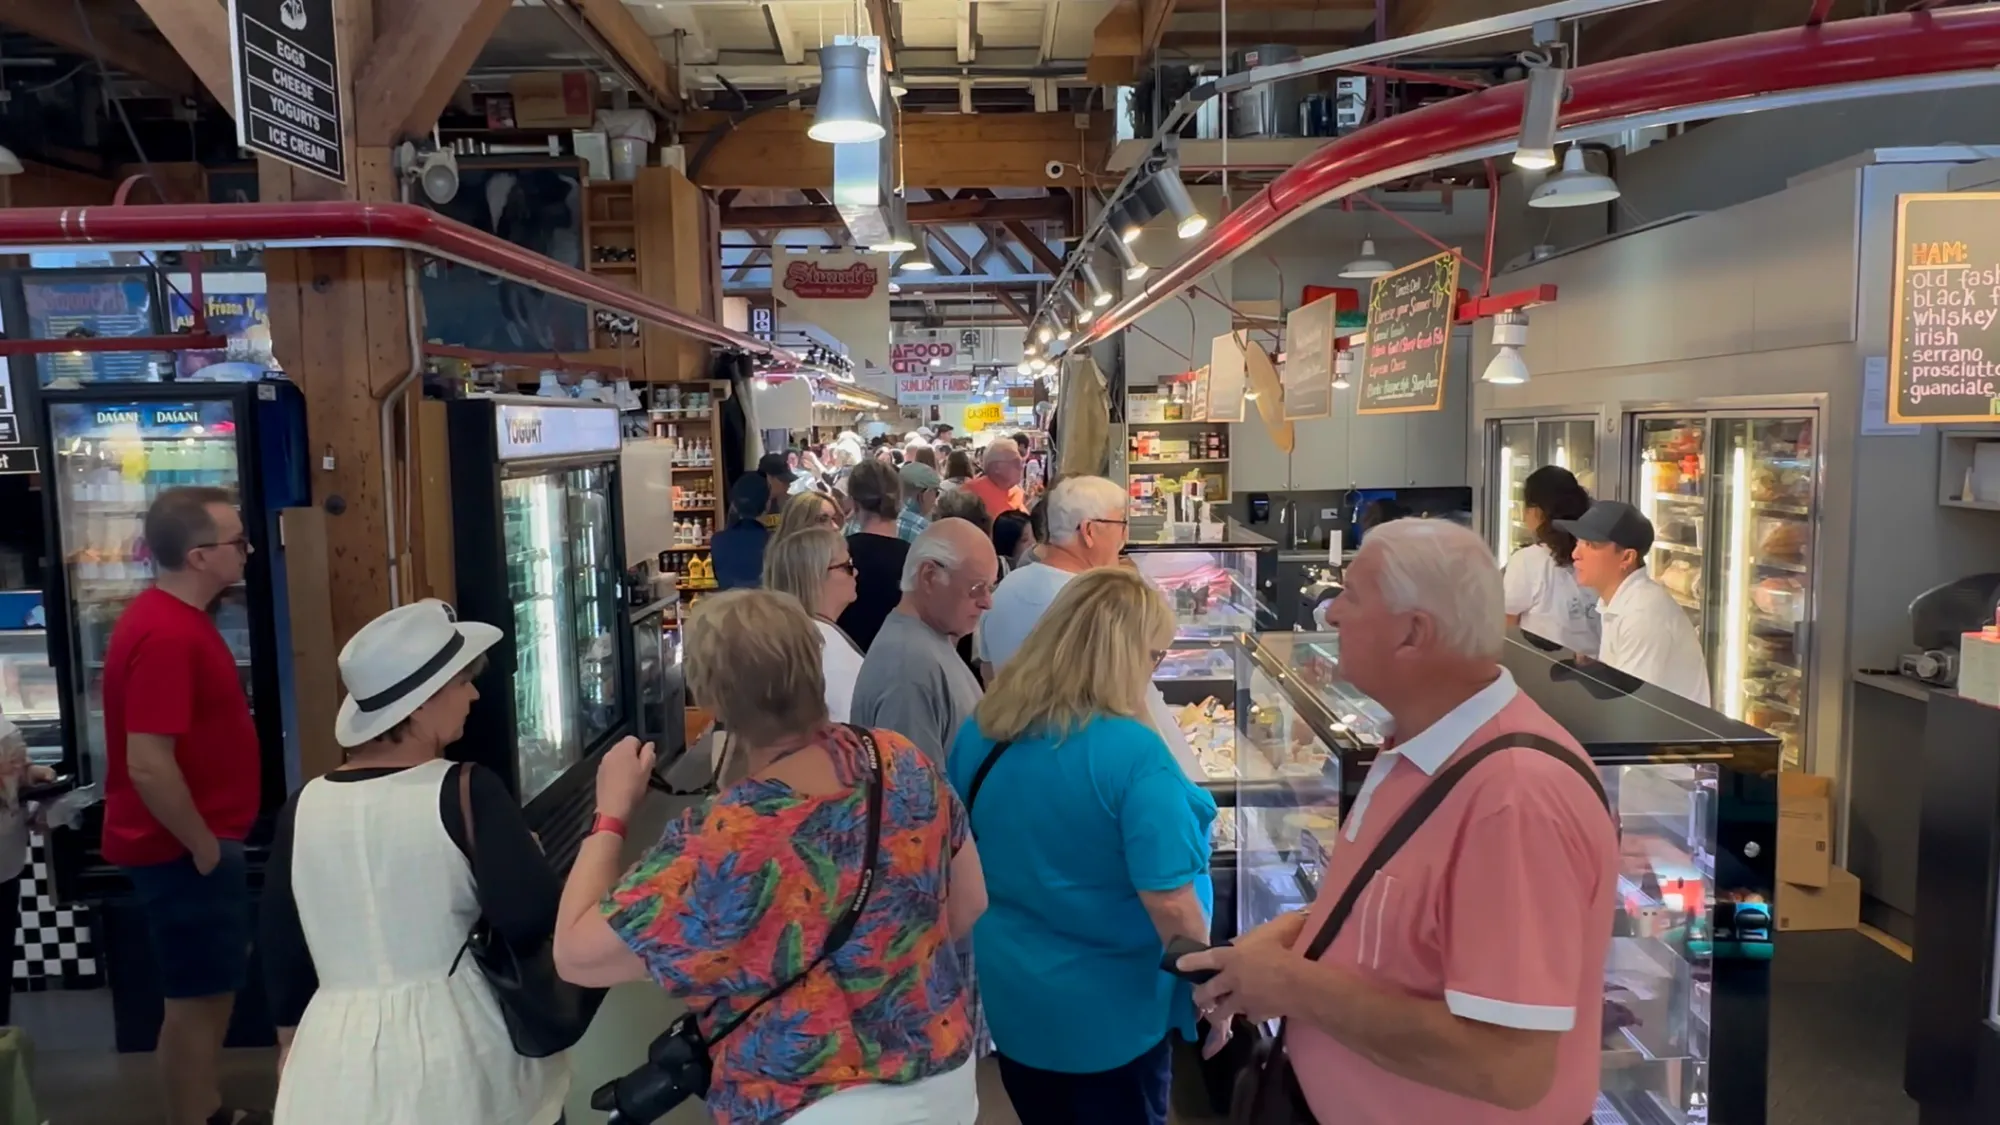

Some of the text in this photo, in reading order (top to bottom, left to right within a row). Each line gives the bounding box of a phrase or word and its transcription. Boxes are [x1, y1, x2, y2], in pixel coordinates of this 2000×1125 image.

[276, 40, 306, 69] EGGS
[272, 68, 314, 101] CHEESE
[269, 94, 320, 131] YOGURTS
[268, 126, 326, 163] ICE CREAM
[786, 261, 877, 286] Stuart's
[1912, 307, 1998, 331] whiskey
[1914, 327, 1958, 346] irish
[1912, 348, 1983, 363] serrano
[901, 379, 939, 392] SUNLIGHT
[1910, 378, 1994, 404] guanciale
[97, 411, 198, 424] DASANI DASANI
[967, 407, 1000, 419] CASHIER
[504, 416, 542, 445] YOGURT
[862, 735, 877, 770] Canon
[853, 868, 872, 912] Canon
